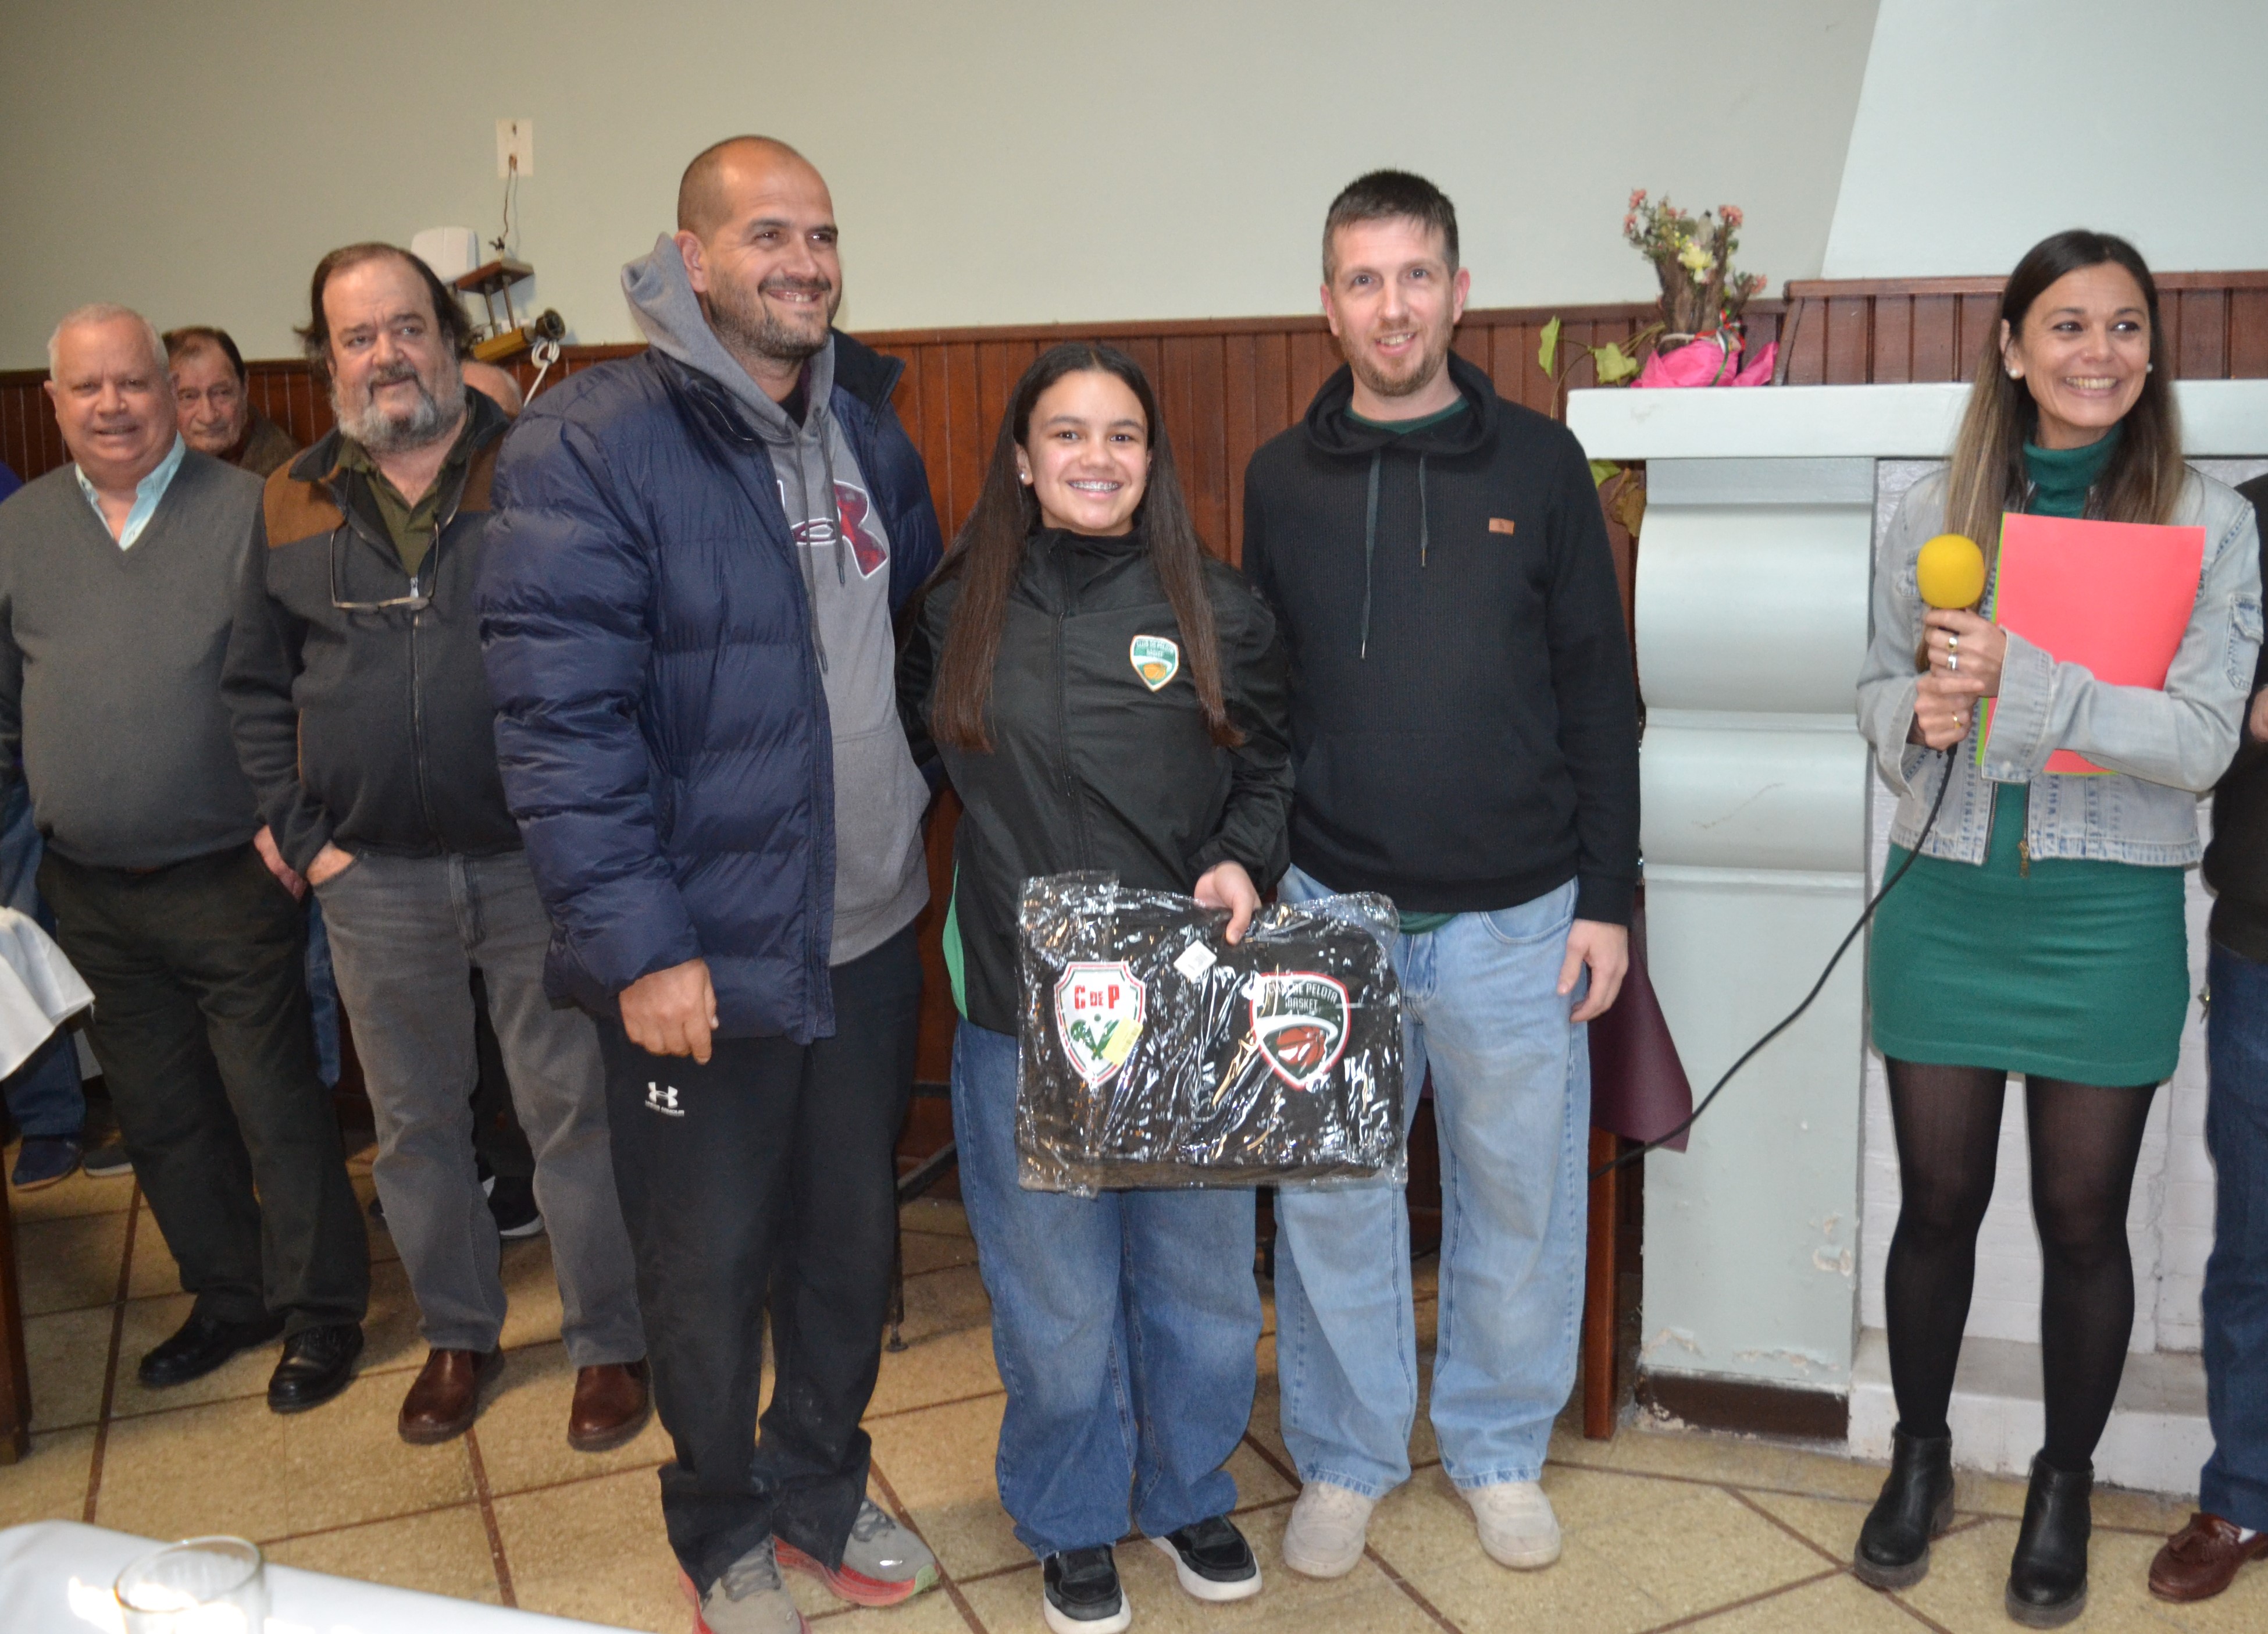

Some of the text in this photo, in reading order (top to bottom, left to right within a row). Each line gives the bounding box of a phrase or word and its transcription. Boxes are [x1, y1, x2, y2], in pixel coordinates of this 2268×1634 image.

[1075, 984, 1119, 1009] C DE P
[1288, 997, 1318, 1011] BASKET
[1306, 982, 1338, 1005] PELOTA
